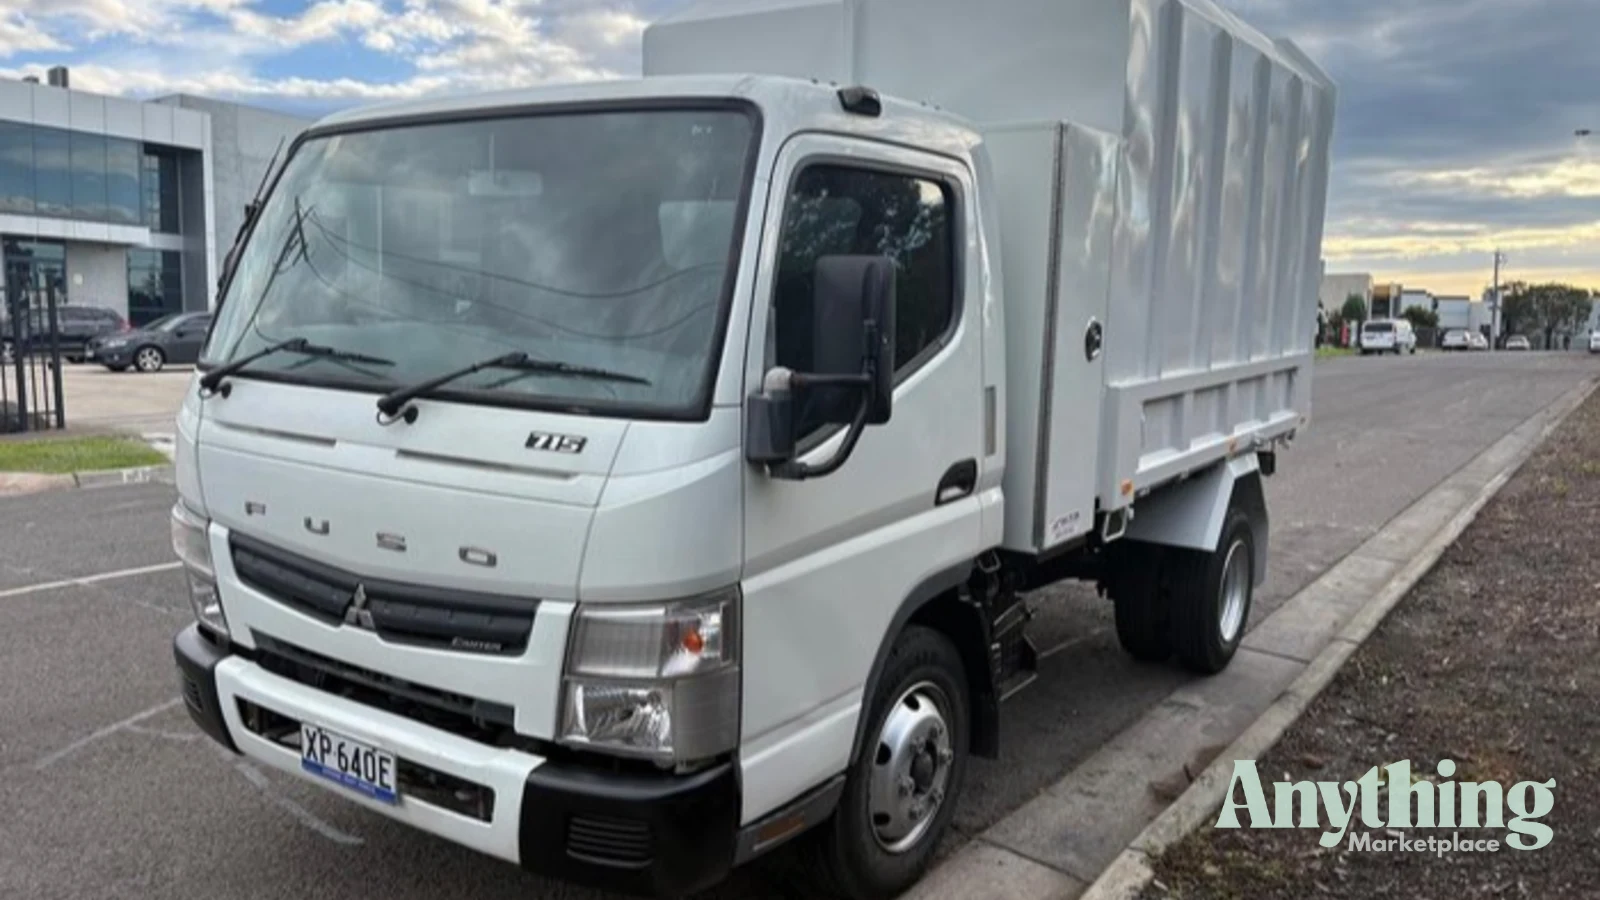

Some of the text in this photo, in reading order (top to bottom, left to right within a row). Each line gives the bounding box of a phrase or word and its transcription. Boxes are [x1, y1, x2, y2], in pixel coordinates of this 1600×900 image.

[529, 432, 584, 453] 715
[245, 501, 497, 568] FUSO
[306, 728, 332, 764] XP
[338, 742, 391, 790] 640E
